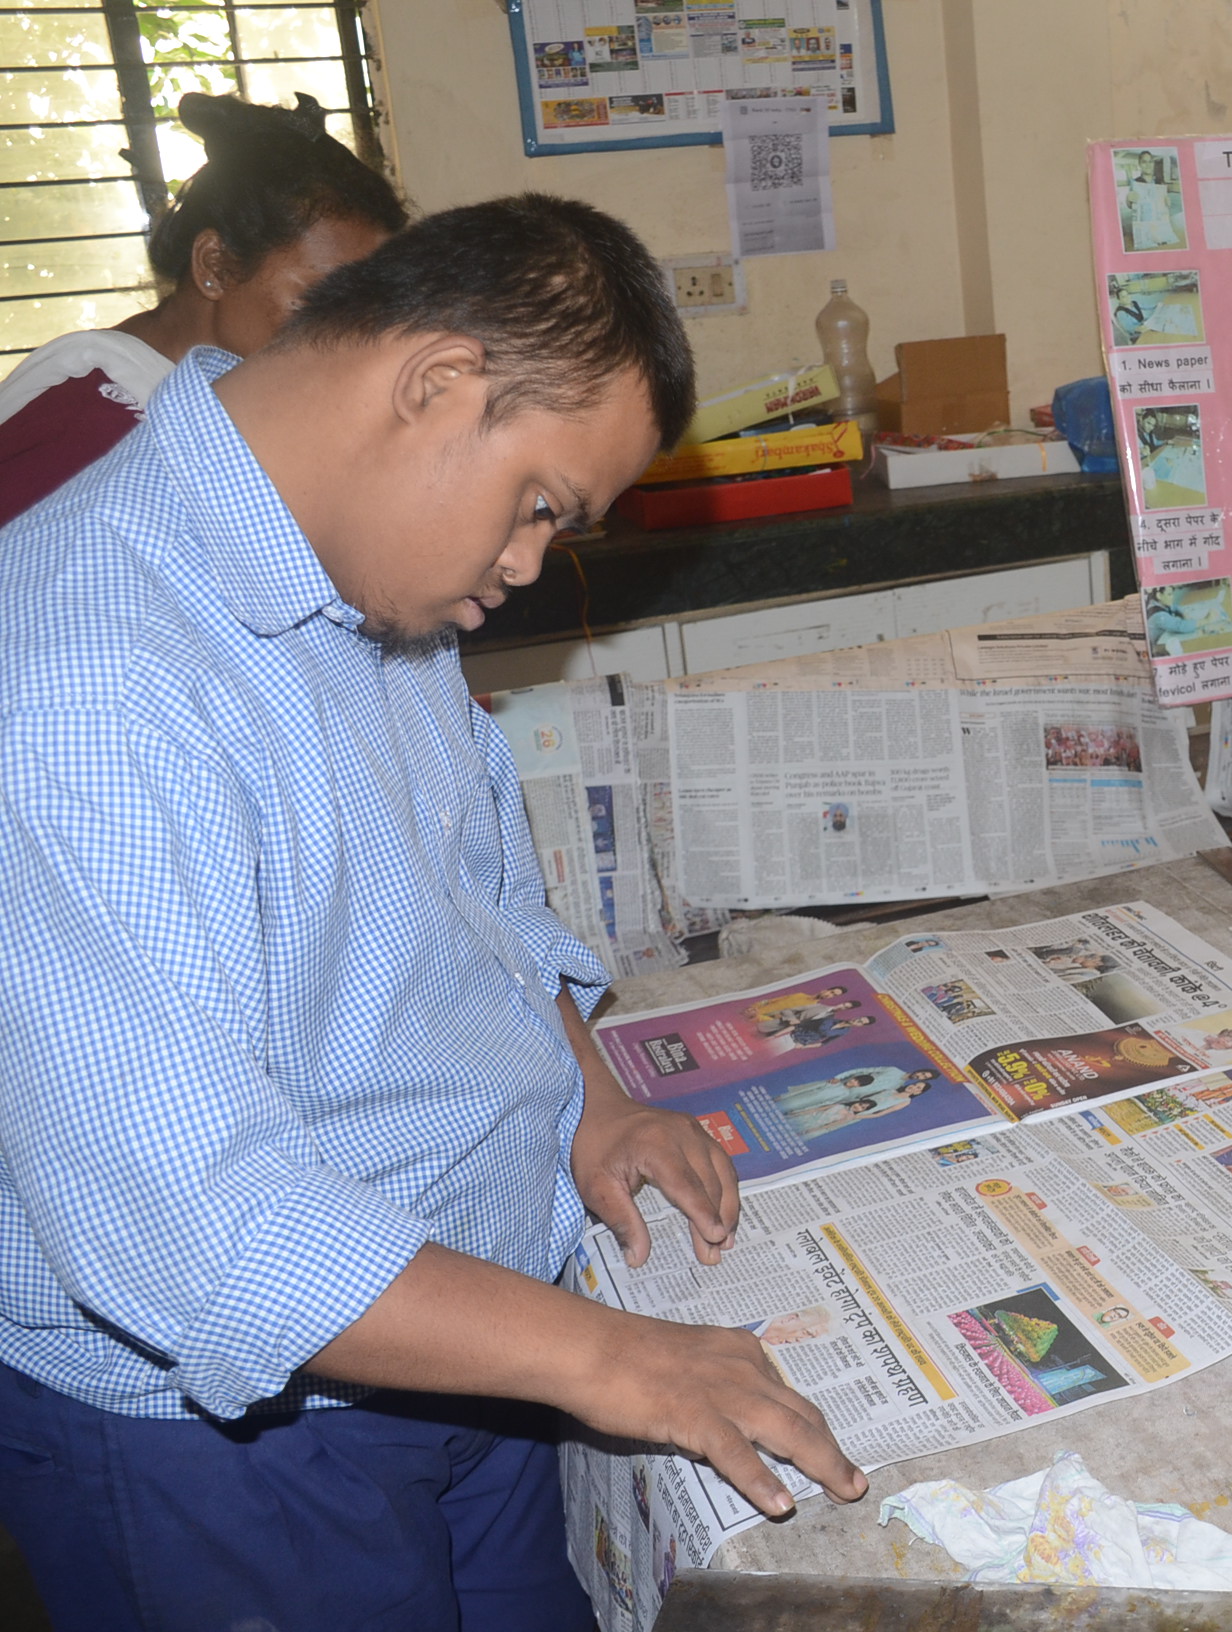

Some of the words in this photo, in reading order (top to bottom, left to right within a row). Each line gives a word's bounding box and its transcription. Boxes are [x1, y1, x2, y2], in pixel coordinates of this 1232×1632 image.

[1121, 361, 1132, 370] 1.
[1138, 358, 1170, 369] News
[1176, 356, 1209, 369] paper
[1119, 381, 1133, 393] को
[1138, 380, 1163, 393] सीधा
[1168, 377, 1201, 391] फैलाना
[753, 435, 834, 466] Shakambari
[1186, 514, 1206, 526] पेपर
[1210, 512, 1220, 523] के
[1137, 539, 1159, 552] नीचे
[1164, 538, 1183, 550] भाग
[1188, 534, 1198, 547] में
[1162, 558, 1193, 570] लगाना
[1192, 660, 1206, 679] हुए
[1210, 654, 1230, 668] पेपर
[1158, 682, 1196, 698] fevicol
[1201, 676, 1231, 690] लगाना
[541, 728, 558, 749] 26
[1079, 910, 1134, 942] शीतलहर
[1118, 936, 1145, 951] की
[1128, 945, 1181, 976] चेतावनी,
[1166, 973, 1206, 995] कांके
[665, 1041, 692, 1063] Bina
[1056, 1048, 1100, 1079] ANAND
[997, 1050, 1033, 1080] 5.9%
[1027, 1079, 1053, 1100] 0%
[1049, 1098, 1072, 1108] SUNDAY
[1071, 1094, 1088, 1103] OPEN
[717, 1125, 738, 1140] Bina
[791, 1228, 832, 1264] ग्लोबल
[813, 1261, 849, 1287] इवेंट
[829, 1284, 868, 1311] होगा
[858, 1326, 885, 1345] का
[870, 1344, 907, 1376] शपथ
[892, 1374, 928, 1406] ग्रहण
